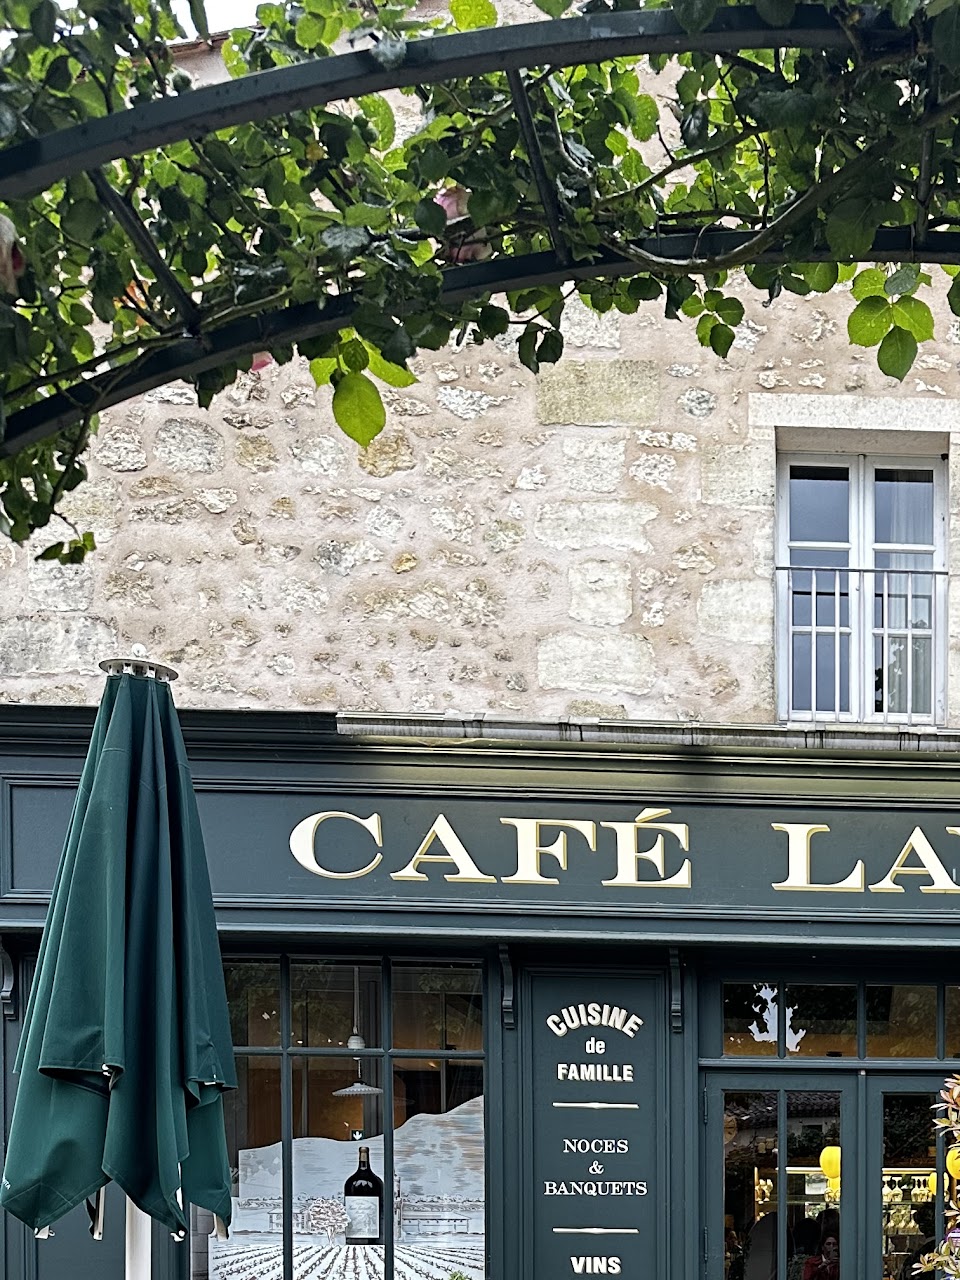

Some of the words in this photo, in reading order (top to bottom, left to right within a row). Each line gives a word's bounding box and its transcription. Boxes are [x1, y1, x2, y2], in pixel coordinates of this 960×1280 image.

[289, 808, 692, 889] CAFÉ
[546, 1002, 644, 1039] CUISINE
[585, 1037, 606, 1054] de
[557, 1064, 634, 1082] FAMILLE
[562, 1138, 629, 1154] NOCES
[588, 1160, 604, 1175] &
[544, 1181, 648, 1196] BANQUETS
[570, 1256, 622, 1274] VINS
